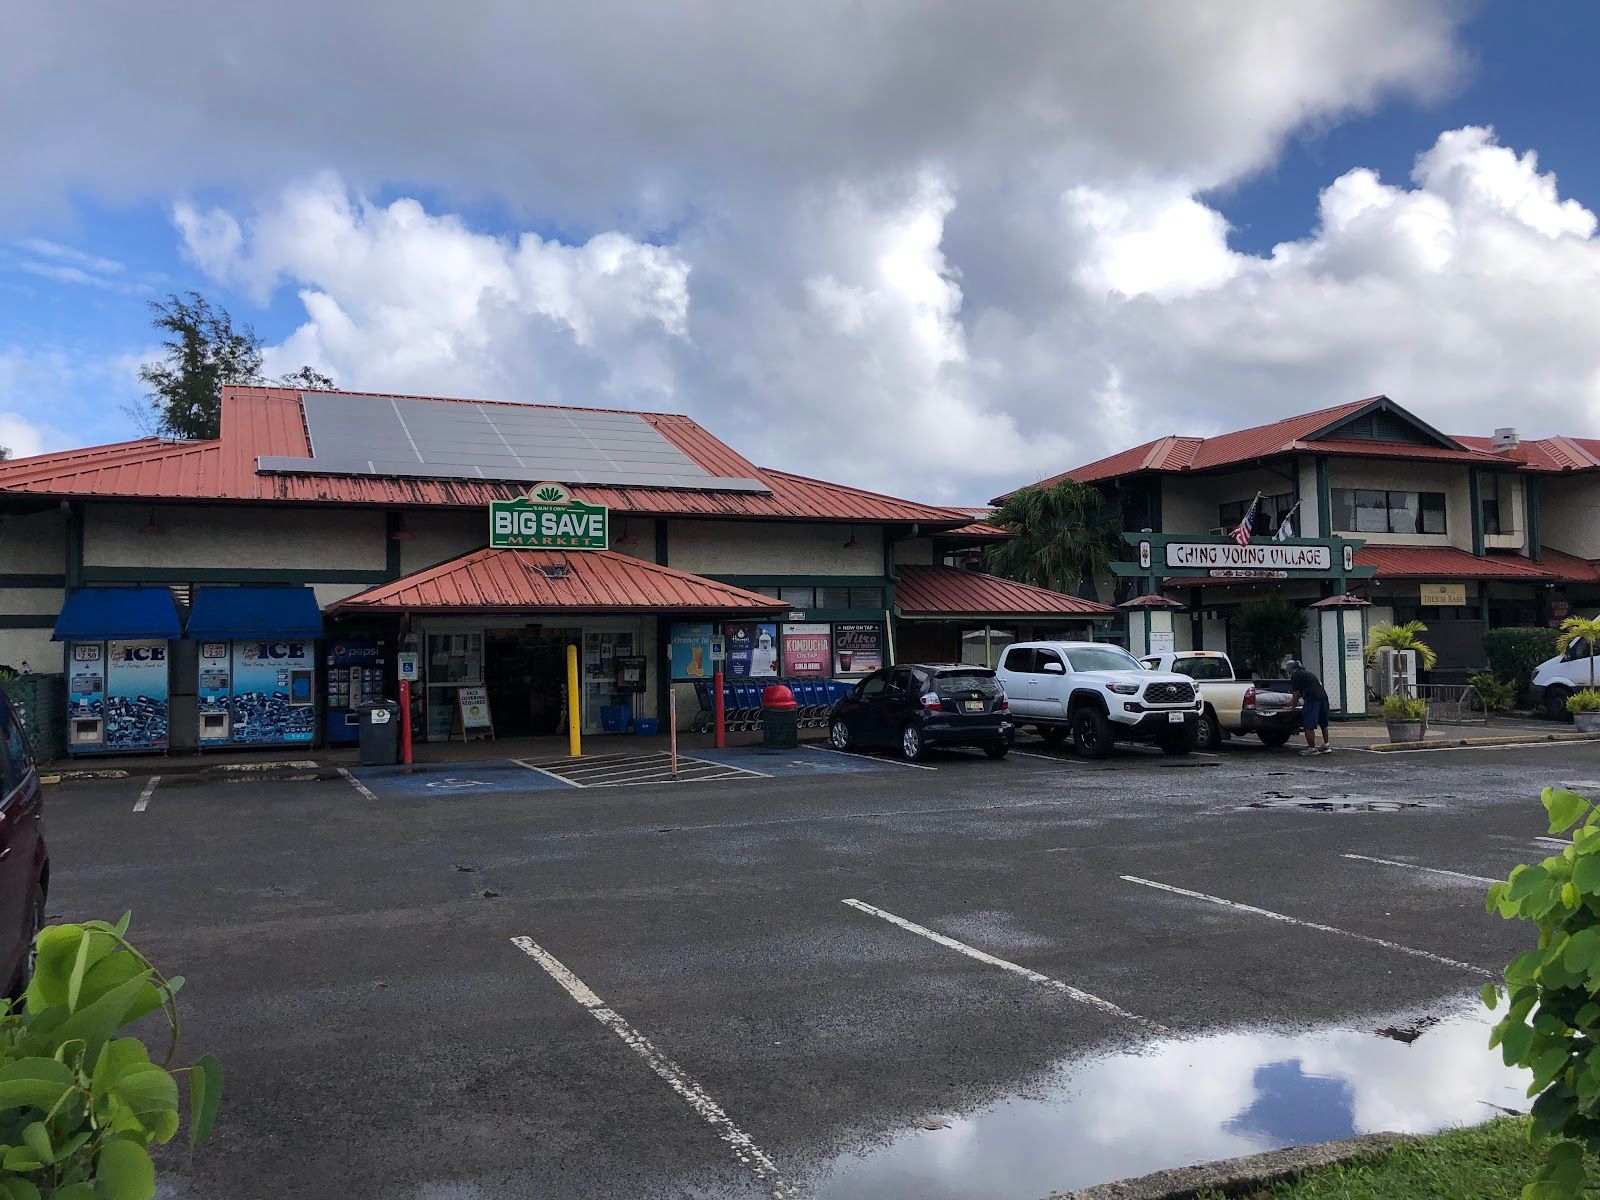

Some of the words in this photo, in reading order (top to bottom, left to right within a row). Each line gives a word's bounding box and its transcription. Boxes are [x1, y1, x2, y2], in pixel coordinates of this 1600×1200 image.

[495, 511, 537, 535] BIG
[541, 512, 604, 537] SAVE
[508, 536, 592, 546] MARKET
[1177, 546, 1217, 565] CHING
[1224, 547, 1265, 565] YOUNG
[1271, 548, 1322, 566] VILLAGE
[786, 639, 829, 652] KOMBUCHA
[837, 632, 877, 647] Nitro
[123, 646, 166, 661] ICE
[258, 643, 305, 659] ICE
[348, 648, 379, 657] pepsi
[794, 662, 808, 670] SOLD
[808, 662, 822, 670] HERE
